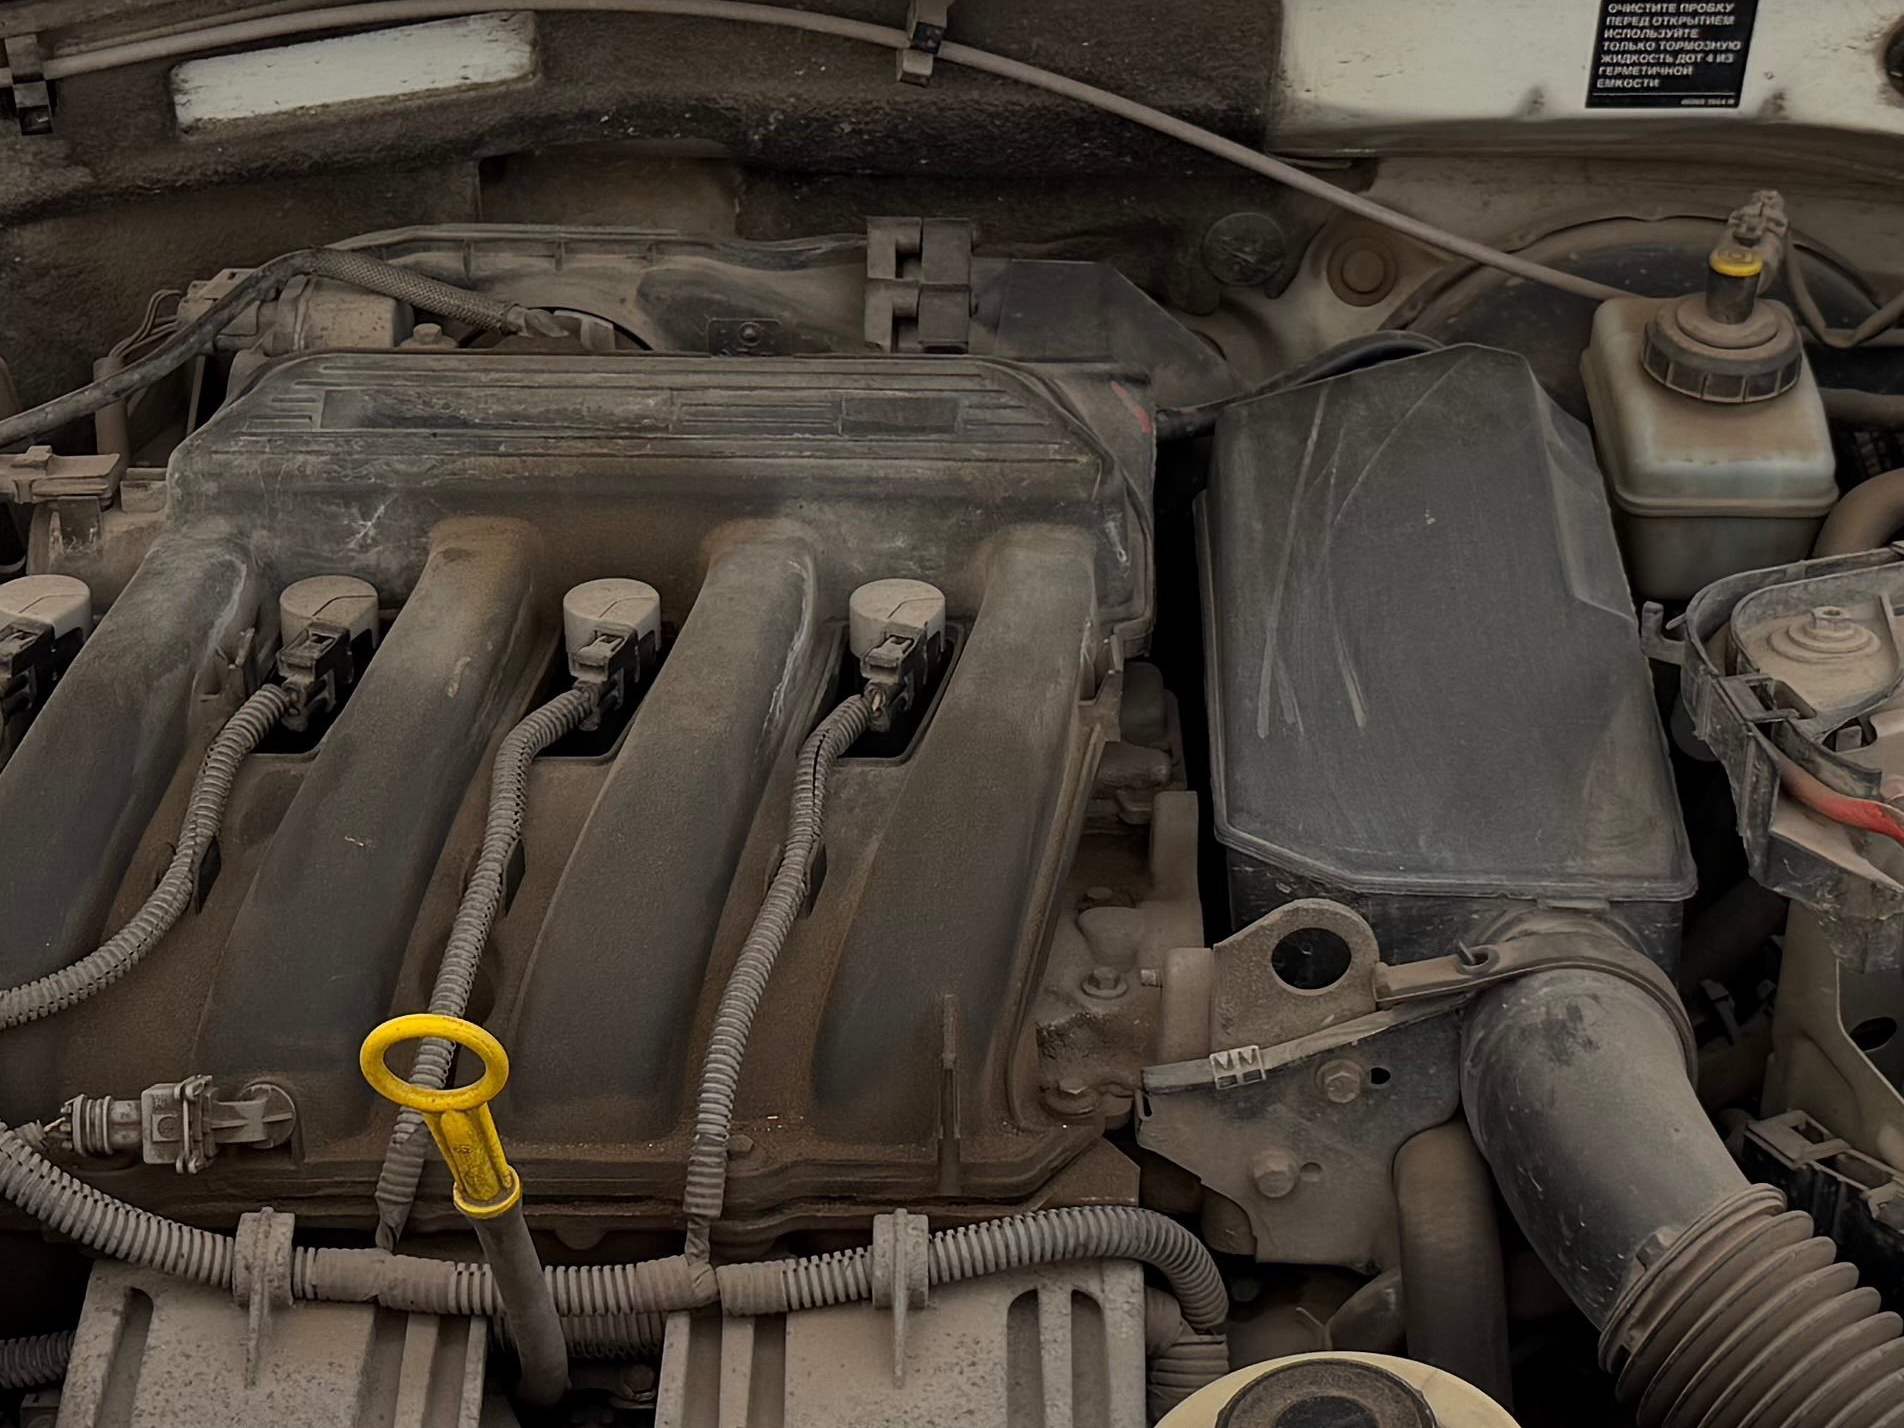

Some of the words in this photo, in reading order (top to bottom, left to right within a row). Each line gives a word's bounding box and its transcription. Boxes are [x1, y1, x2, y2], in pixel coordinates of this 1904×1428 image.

[1608, 3, 1677, 13] ОЧИСТИТЕ
[1680, 3, 1735, 13] ПРОБКУ
[1606, 16, 1648, 26] ПЕРЕД
[1652, 16, 1735, 26] ОТКРЫТИЕМ
[1604, 28, 1699, 38] ИСПОЛЬЗУЙТЕ
[1603, 41, 1655, 50] ТОЛЬКО
[1659, 41, 1741, 50] ТОРМОЗНУЮ
[1601, 54, 1673, 63] ЖИДКОСТЬ
[1676, 54, 1702, 63] ДОТ
[1706, 54, 1714, 62] 4
[1716, 54, 1734, 62] ИЗ
[1599, 66, 1693, 76] ГЕРМЕТИЧНОЙ
[1597, 79, 1660, 88] ЕМКОСТИ
